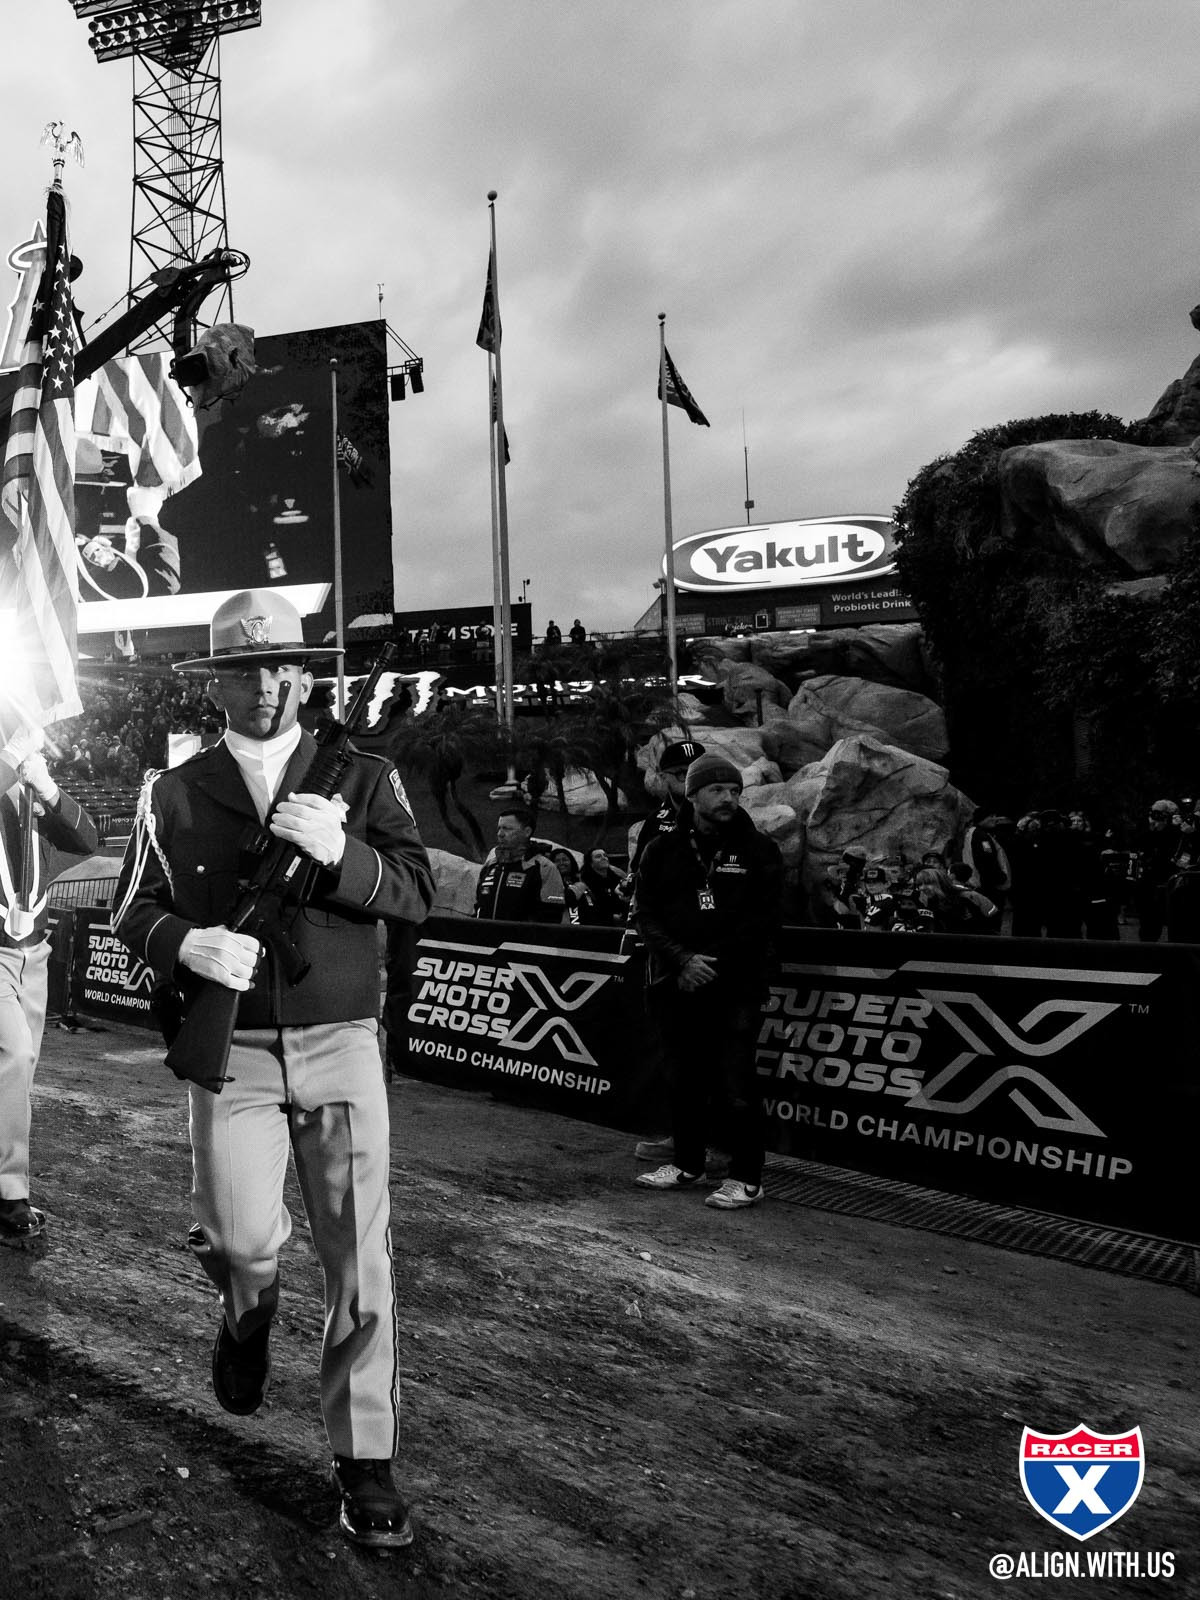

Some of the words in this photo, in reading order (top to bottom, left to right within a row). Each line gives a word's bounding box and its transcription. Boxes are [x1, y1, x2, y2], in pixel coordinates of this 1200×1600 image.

[703, 533, 874, 574] Yakult
[831, 592, 868, 602] World's
[834, 602, 880, 612] Probiotic
[882, 600, 911, 609] Drink
[86, 966, 129, 985] CROSS
[90, 951, 129, 969] MOTO
[412, 957, 516, 991] SUPER
[85, 988, 109, 1002] WORLD
[111, 993, 151, 1011] CHAMPION
[417, 981, 510, 1014] MOTO
[760, 986, 934, 1029] SUPER
[407, 1003, 511, 1040] CROSS
[757, 1017, 922, 1062] MOTO
[408, 1037, 467, 1062] WORLD
[471, 1052, 611, 1095] CHAMPIONSHIP
[755, 1048, 926, 1097] CROSS
[857, 1114, 1133, 1180] CHAMPIONSHIP
